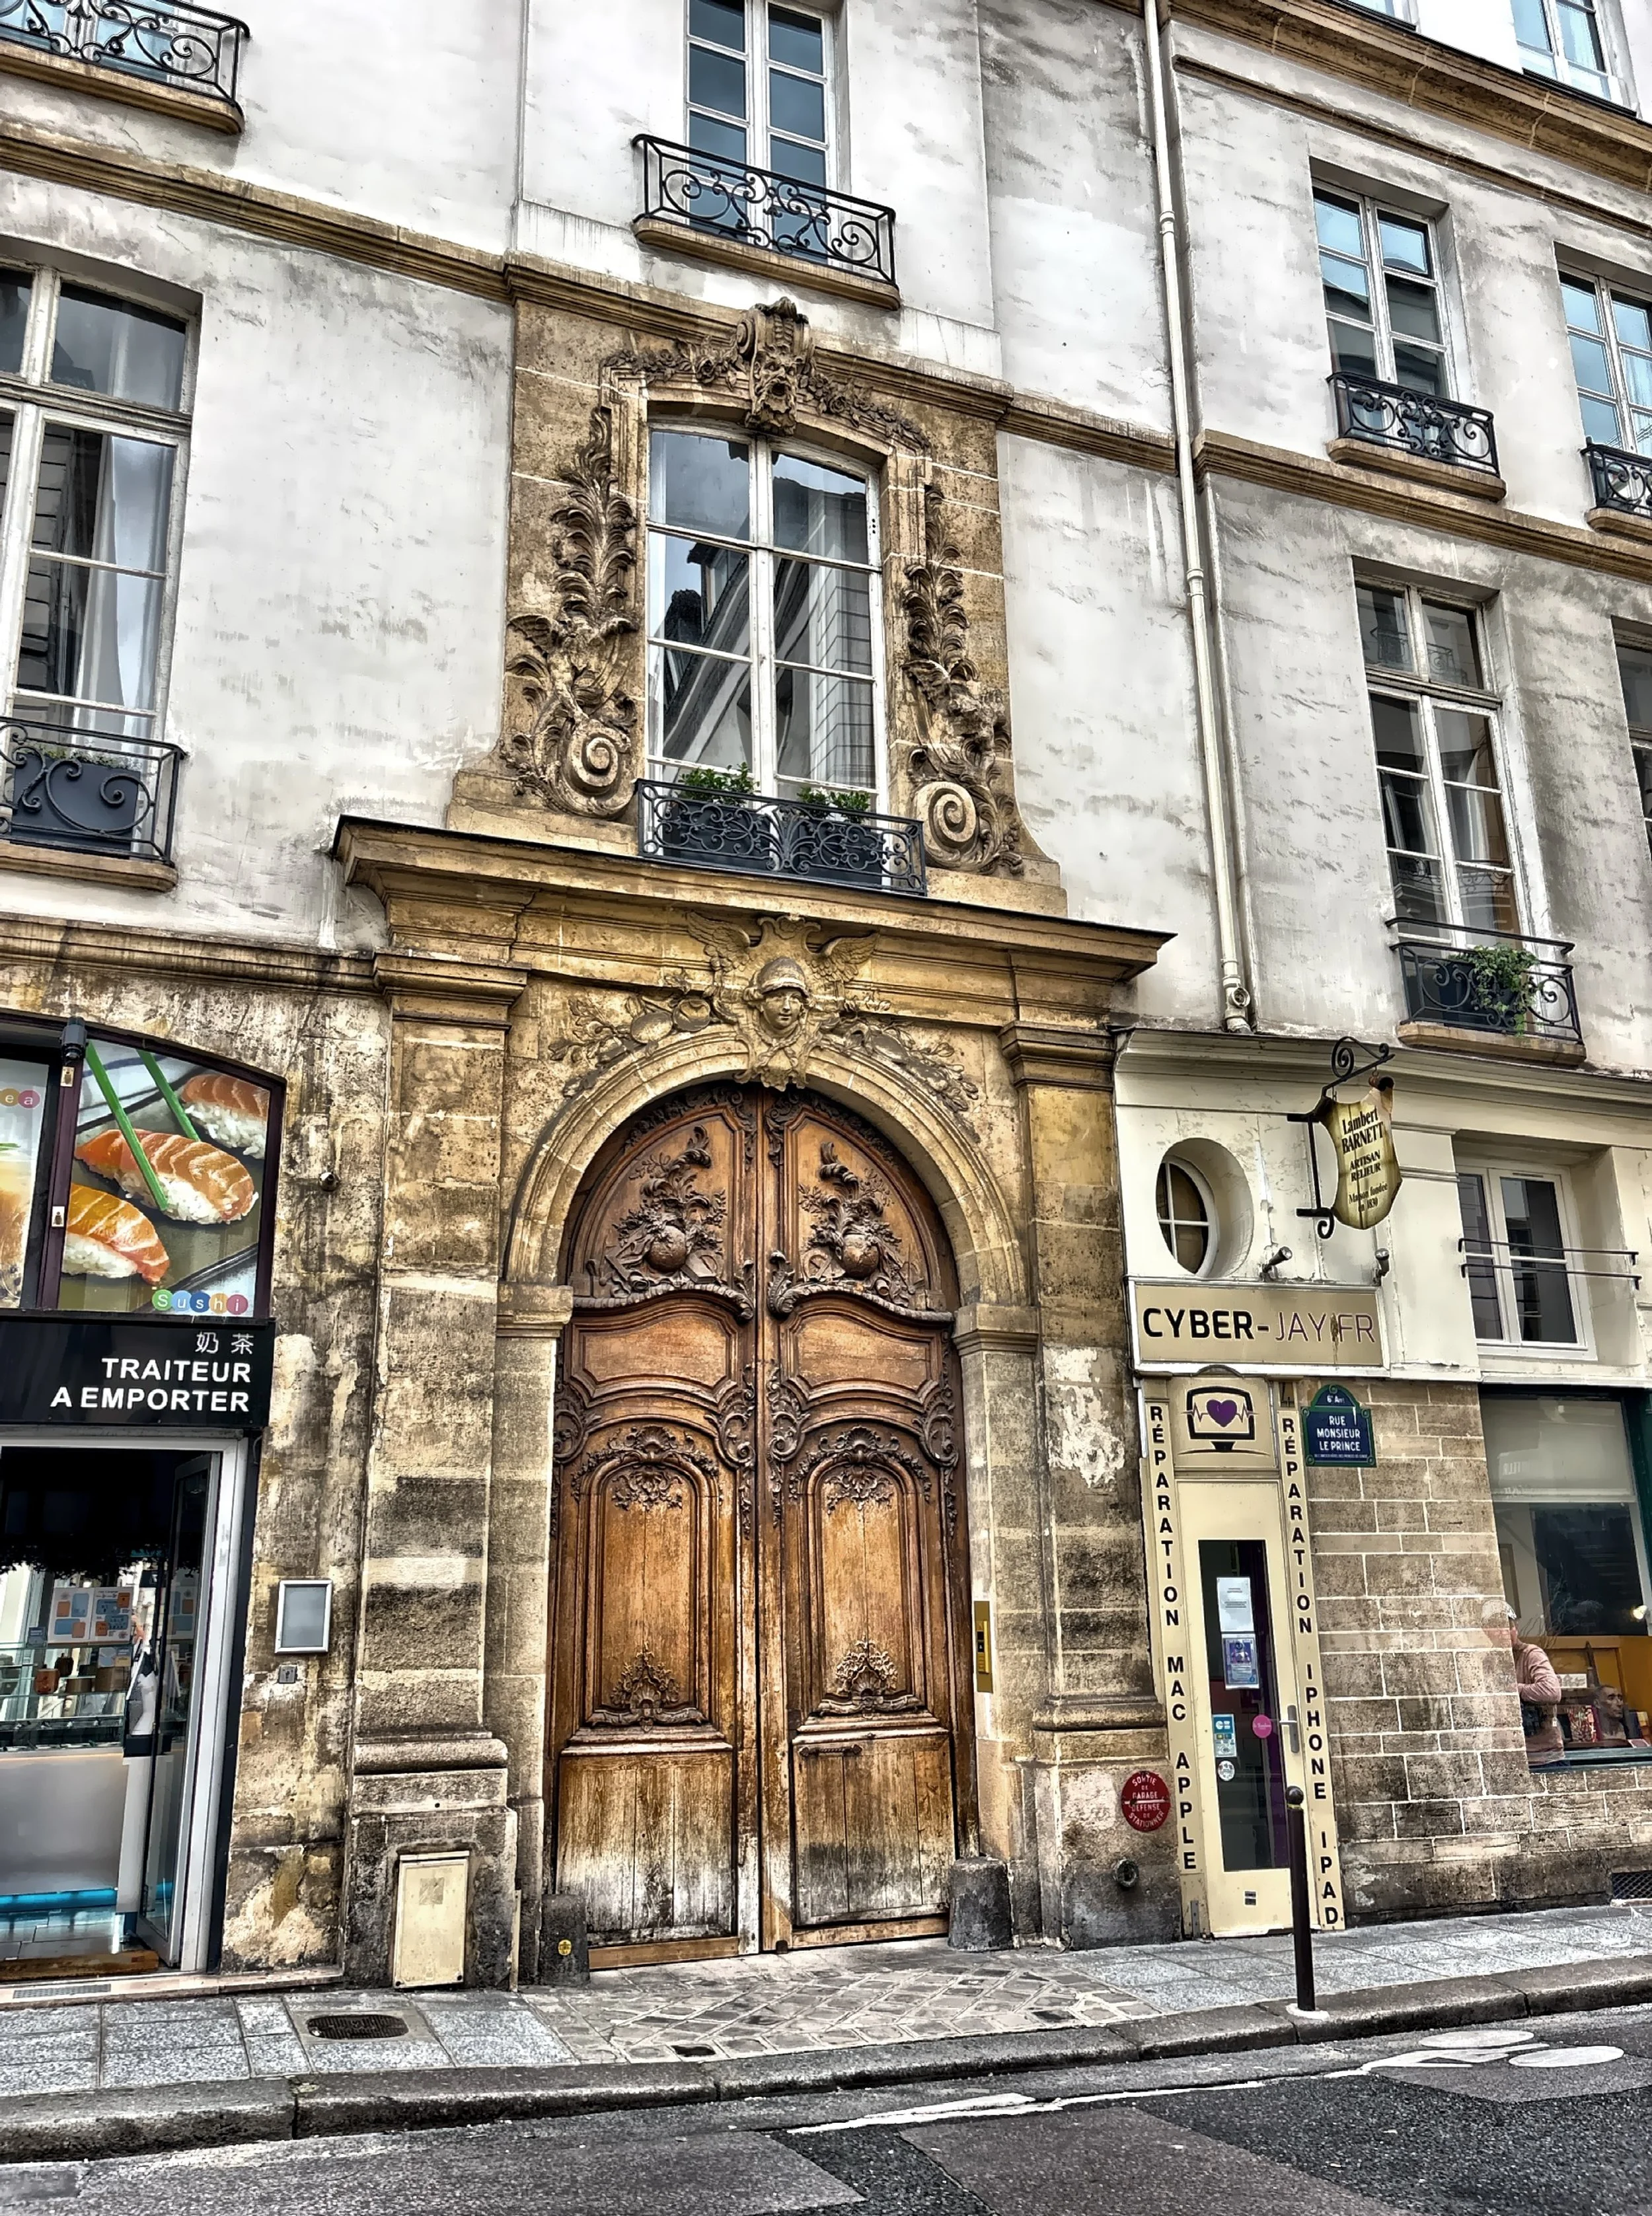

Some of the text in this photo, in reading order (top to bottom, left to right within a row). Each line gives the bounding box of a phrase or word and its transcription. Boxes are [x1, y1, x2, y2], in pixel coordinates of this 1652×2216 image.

[1341, 1106, 1379, 1135] Lambert
[1341, 1122, 1384, 1154] BARNETT
[1349, 1150, 1380, 1170] ARTISAN
[1351, 1163, 1381, 1182] RELIEUR
[1367, 1197, 1378, 1210] 1830
[157, 1293, 243, 1313] Sushi
[102, 1358, 250, 1383] TRAITEUR
[50, 1387, 249, 1412] A EMPORTER
[1328, 1415, 1346, 1426] RUE
[1316, 1428, 1361, 1439] MONSIEUR
[1319, 1441, 1361, 1452] LE PRINCE
[1150, 1405, 1197, 1870] RÉPARATION MAC APPLE
[1282, 1418, 1339, 1925] RÉPARATION IPHONE IPAD
[1132, 1773, 1157, 1787] SORTIE
[1128, 1810, 1164, 1828] STATIONNER
